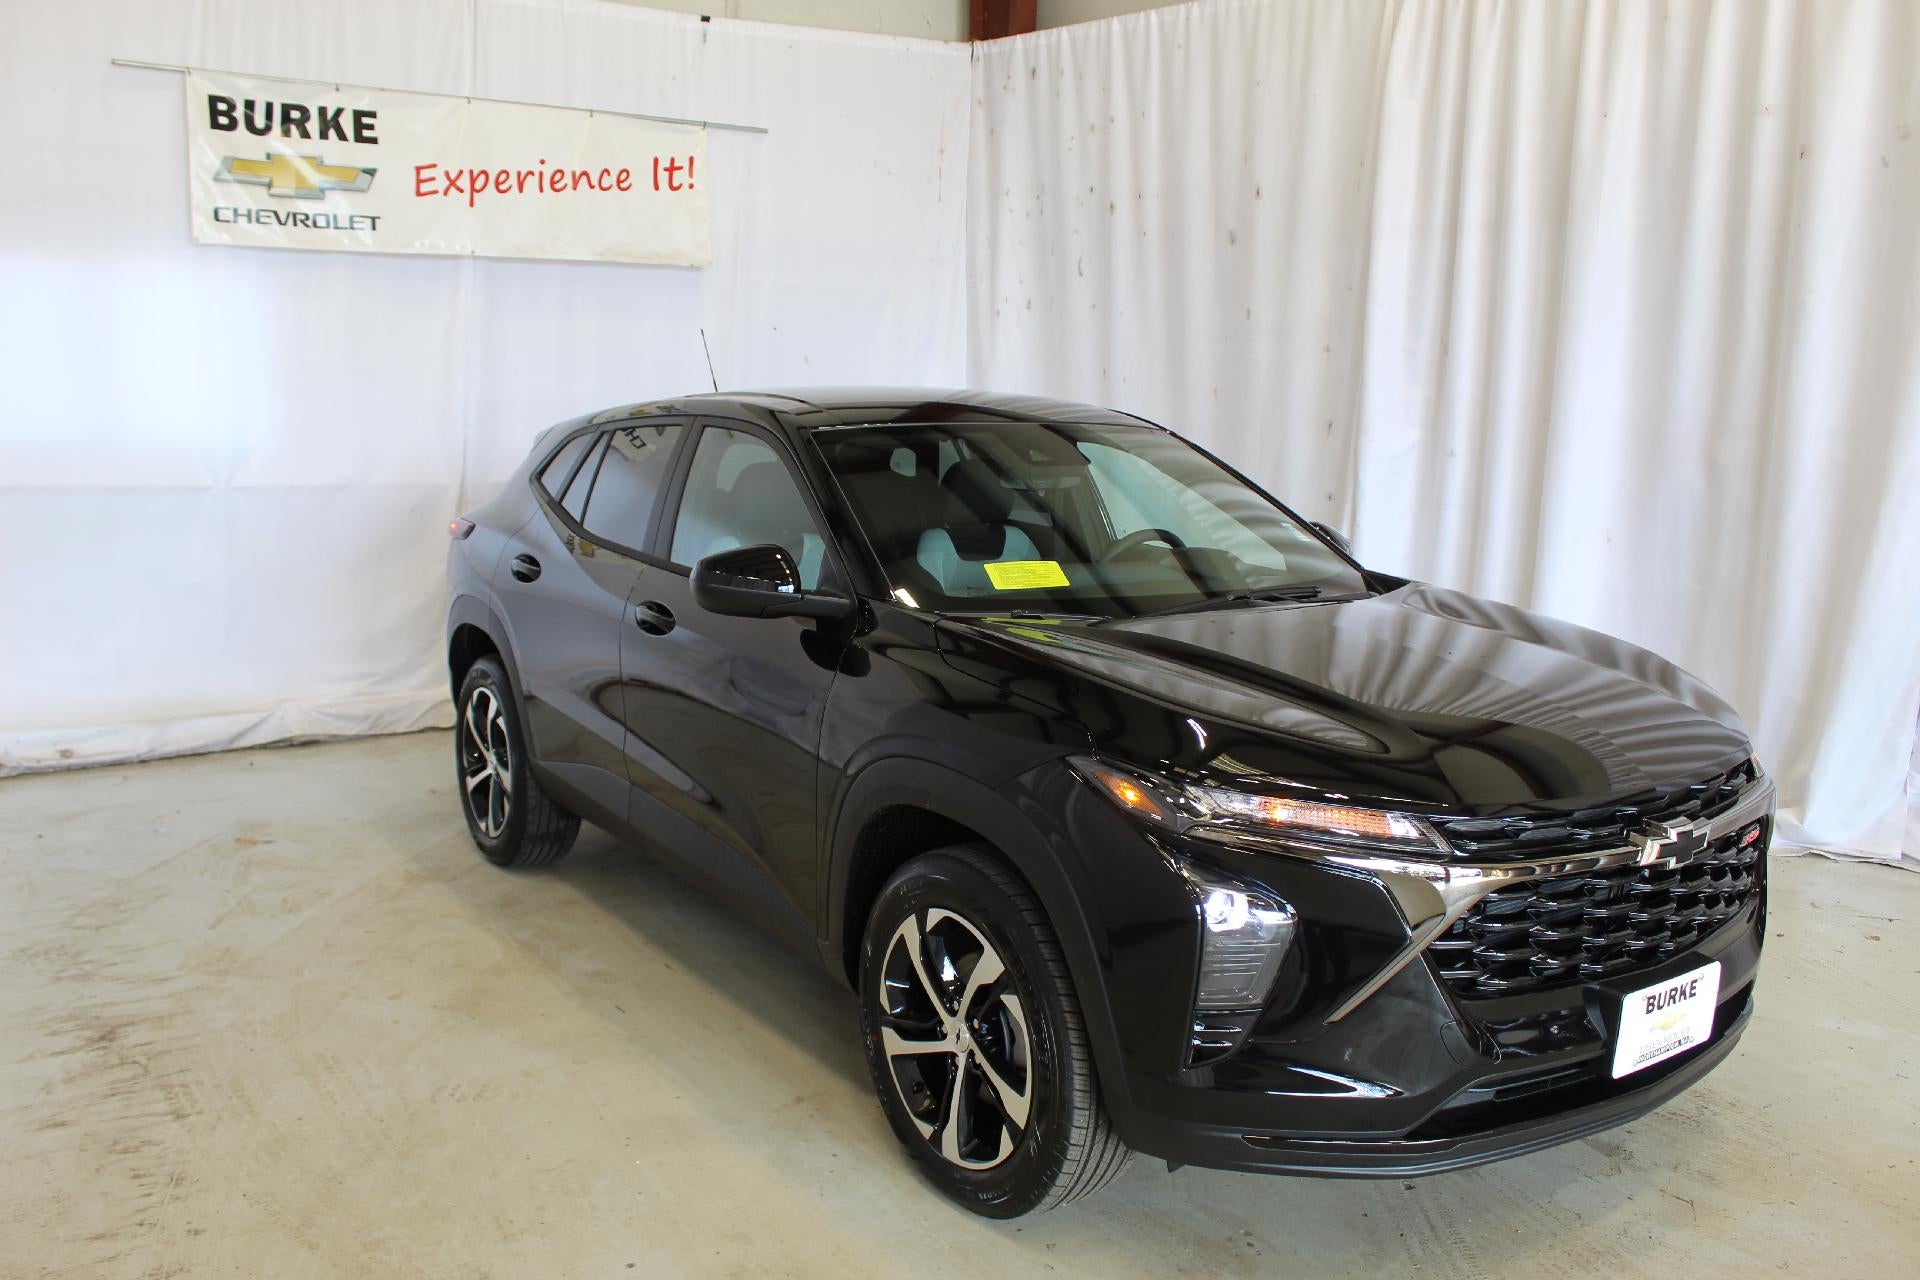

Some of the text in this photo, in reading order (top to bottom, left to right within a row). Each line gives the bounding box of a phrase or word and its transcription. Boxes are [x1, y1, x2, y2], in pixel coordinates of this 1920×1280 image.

[208, 95, 379, 144] BURKE
[414, 156, 695, 207] Experience It!
[213, 206, 381, 231] CHEVROLET
[1645, 979, 1698, 1015] BURKE
